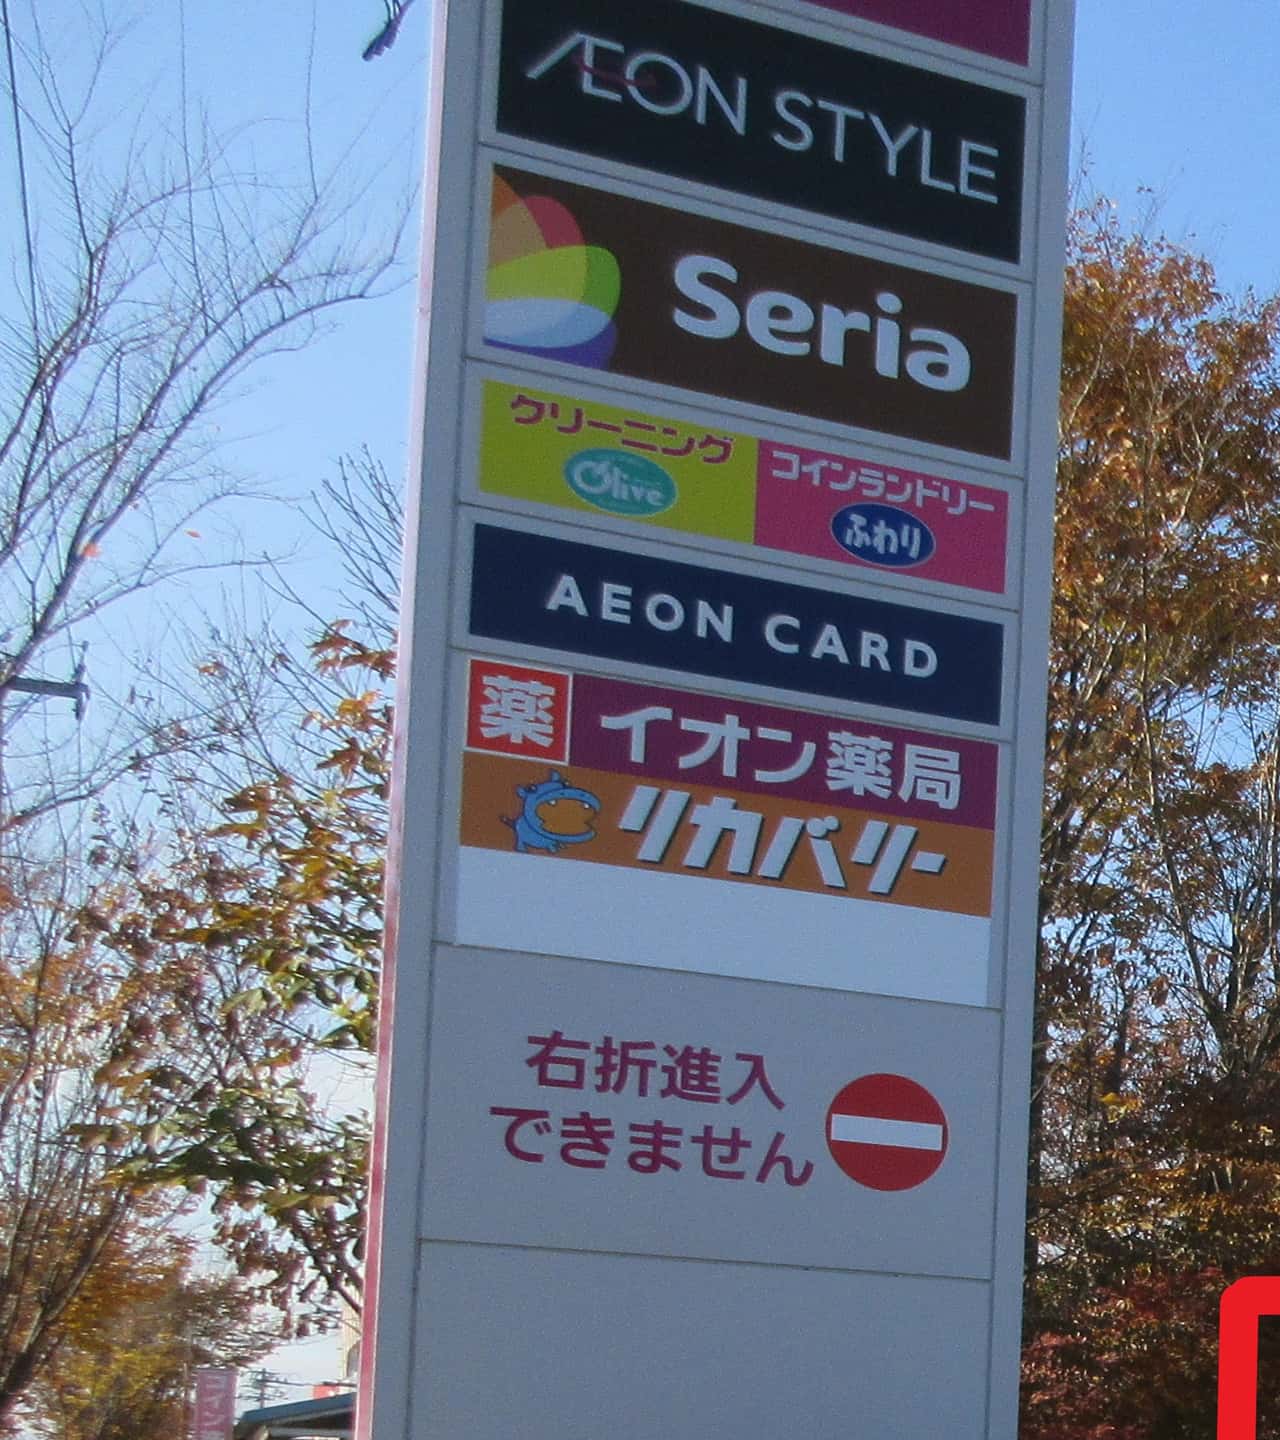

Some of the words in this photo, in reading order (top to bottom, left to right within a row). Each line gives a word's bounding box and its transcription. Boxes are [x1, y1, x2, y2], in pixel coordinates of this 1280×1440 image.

[772, 91, 999, 205] STYLE
[672, 254, 972, 392] Seria
[510, 394, 734, 464] クリーニング
[573, 459, 666, 508] Olive
[771, 449, 996, 516] コインランドリー
[845, 511, 923, 560] ふわり
[546, 574, 735, 643] AEON
[764, 614, 938, 679] CARD
[479, 675, 555, 749] 薬
[600, 706, 962, 811] イオン薬局
[617, 785, 948, 896] リカバリー
[525, 1031, 786, 1110] 右折進入
[489, 1105, 815, 1188] できません
